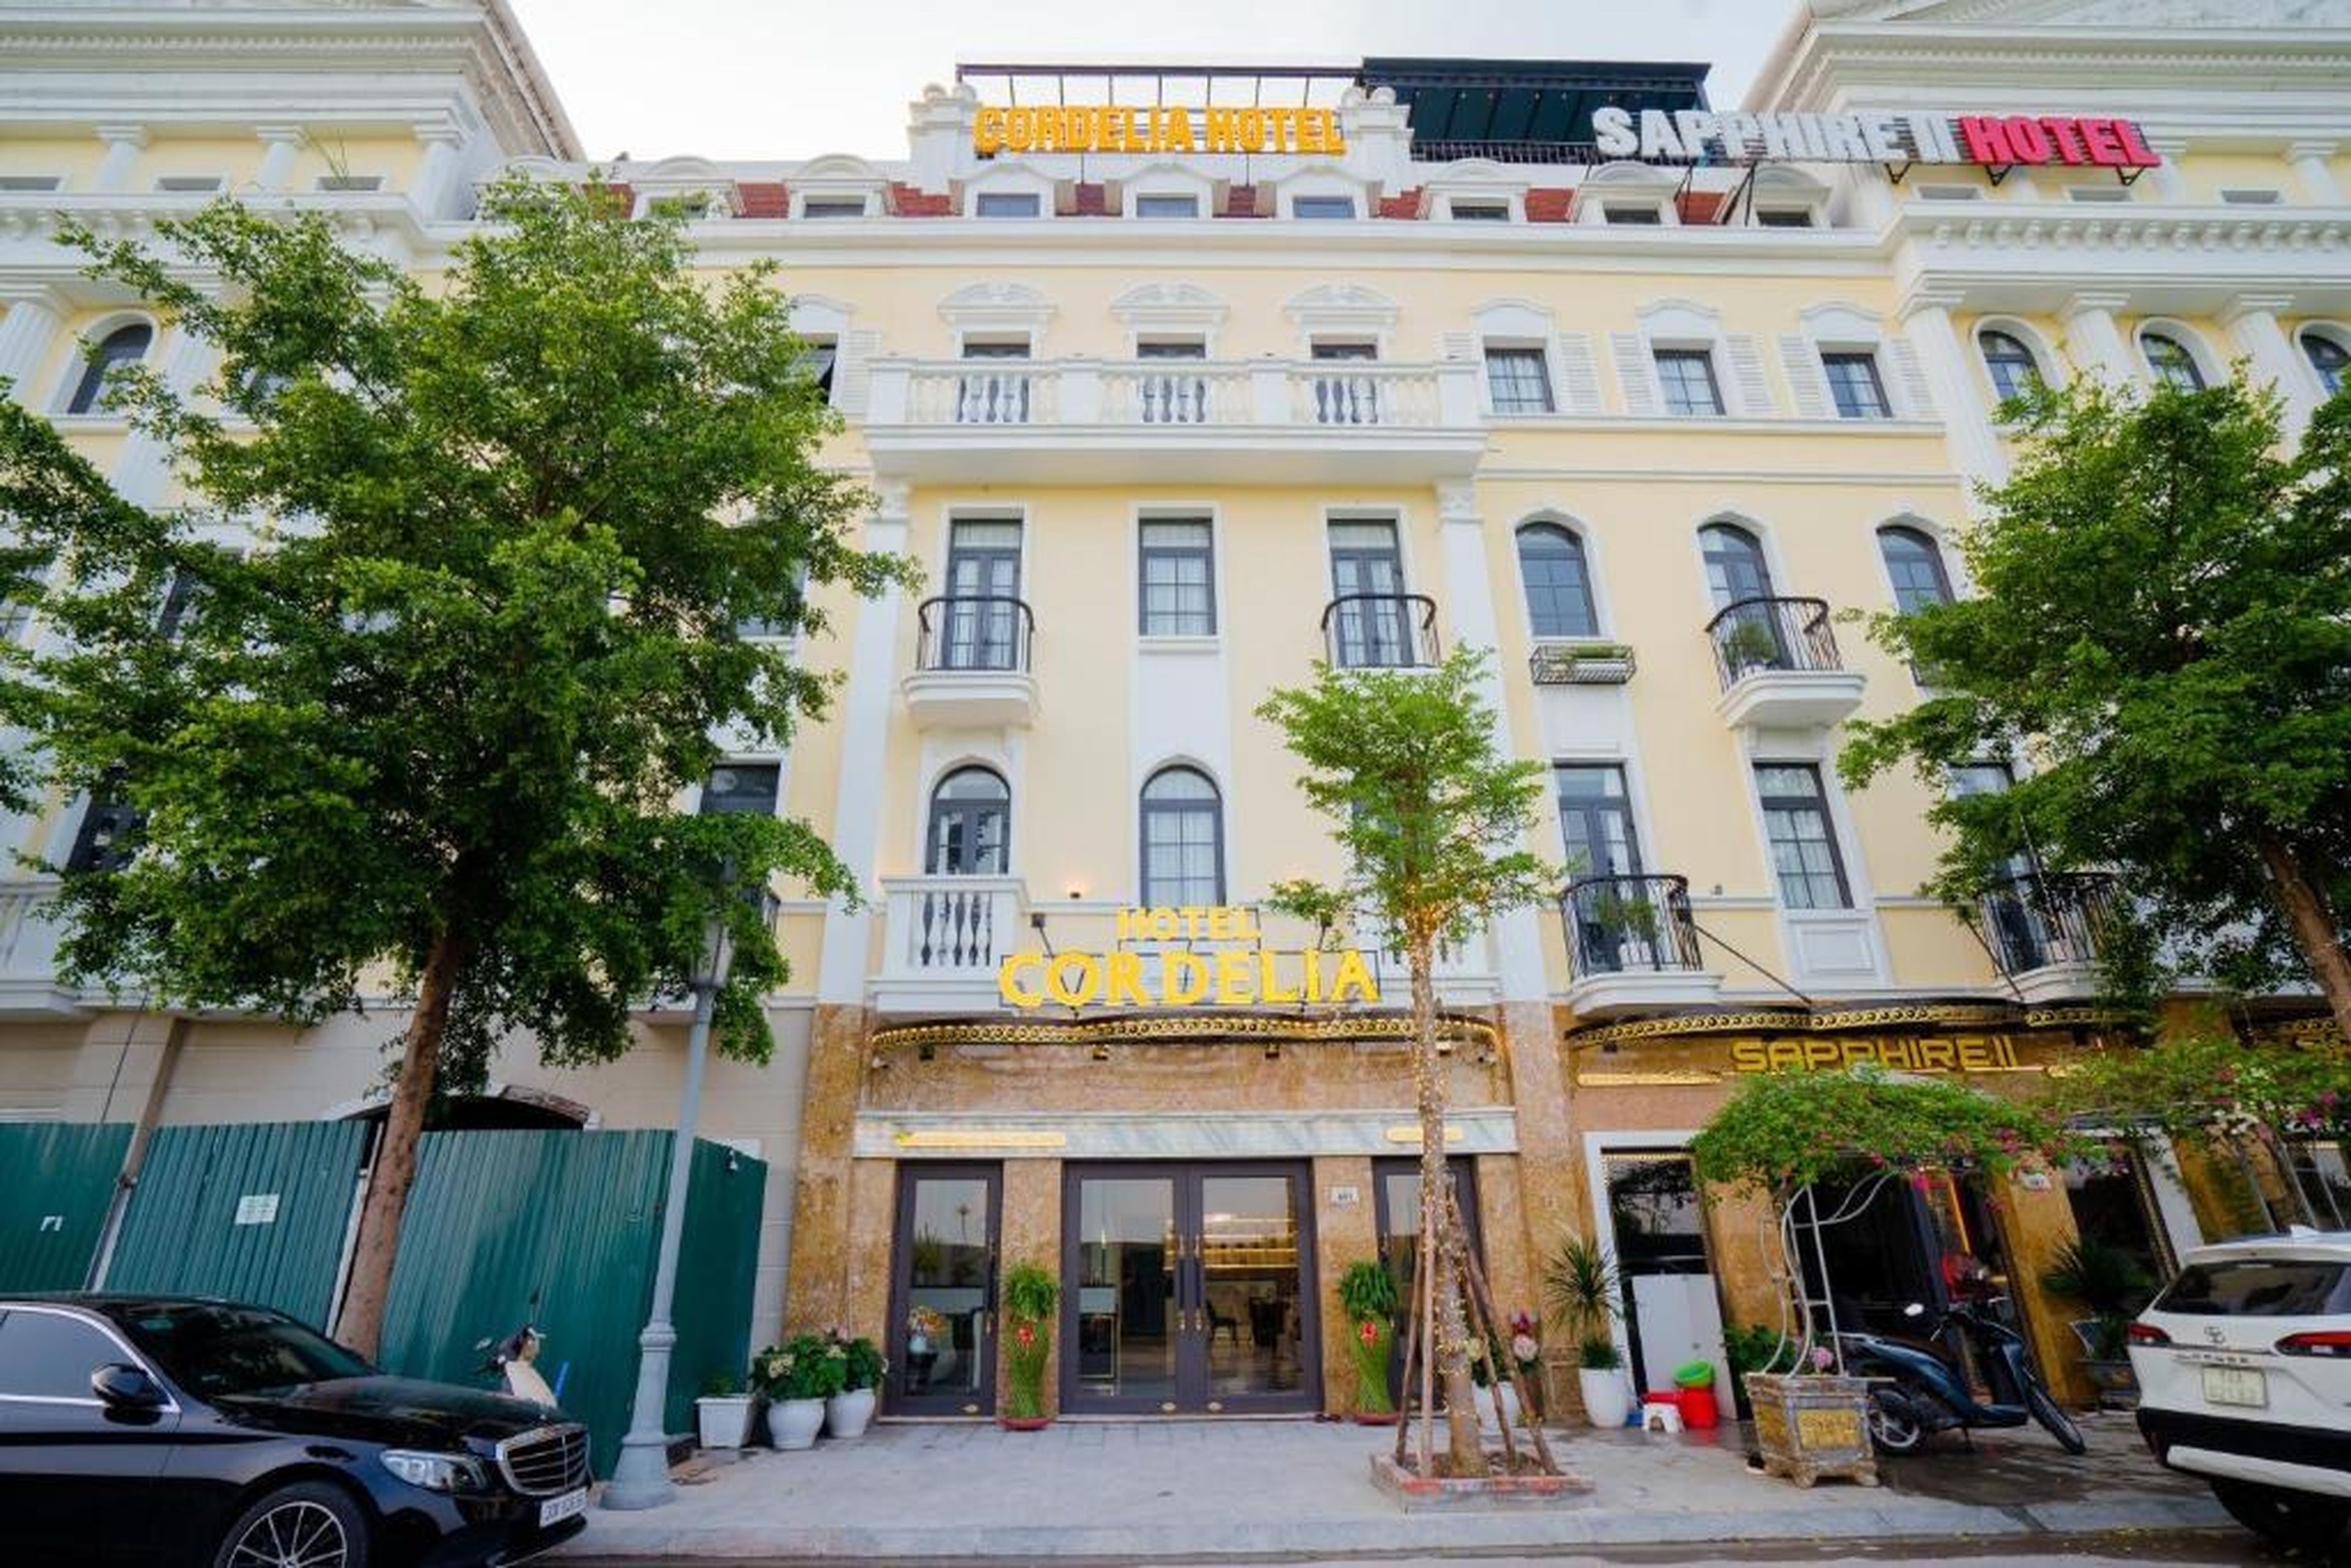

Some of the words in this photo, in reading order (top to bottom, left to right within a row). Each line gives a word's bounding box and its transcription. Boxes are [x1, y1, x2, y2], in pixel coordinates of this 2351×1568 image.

[974, 106, 1194, 152] CORDELIA
[1206, 108, 1346, 154] HOTEL
[1592, 107, 1909, 160] SAPPHIRE
[1959, 116, 2161, 166] HOTEL
[1118, 907, 1260, 940] HOTEL
[999, 948, 1380, 1007] CORDELIA
